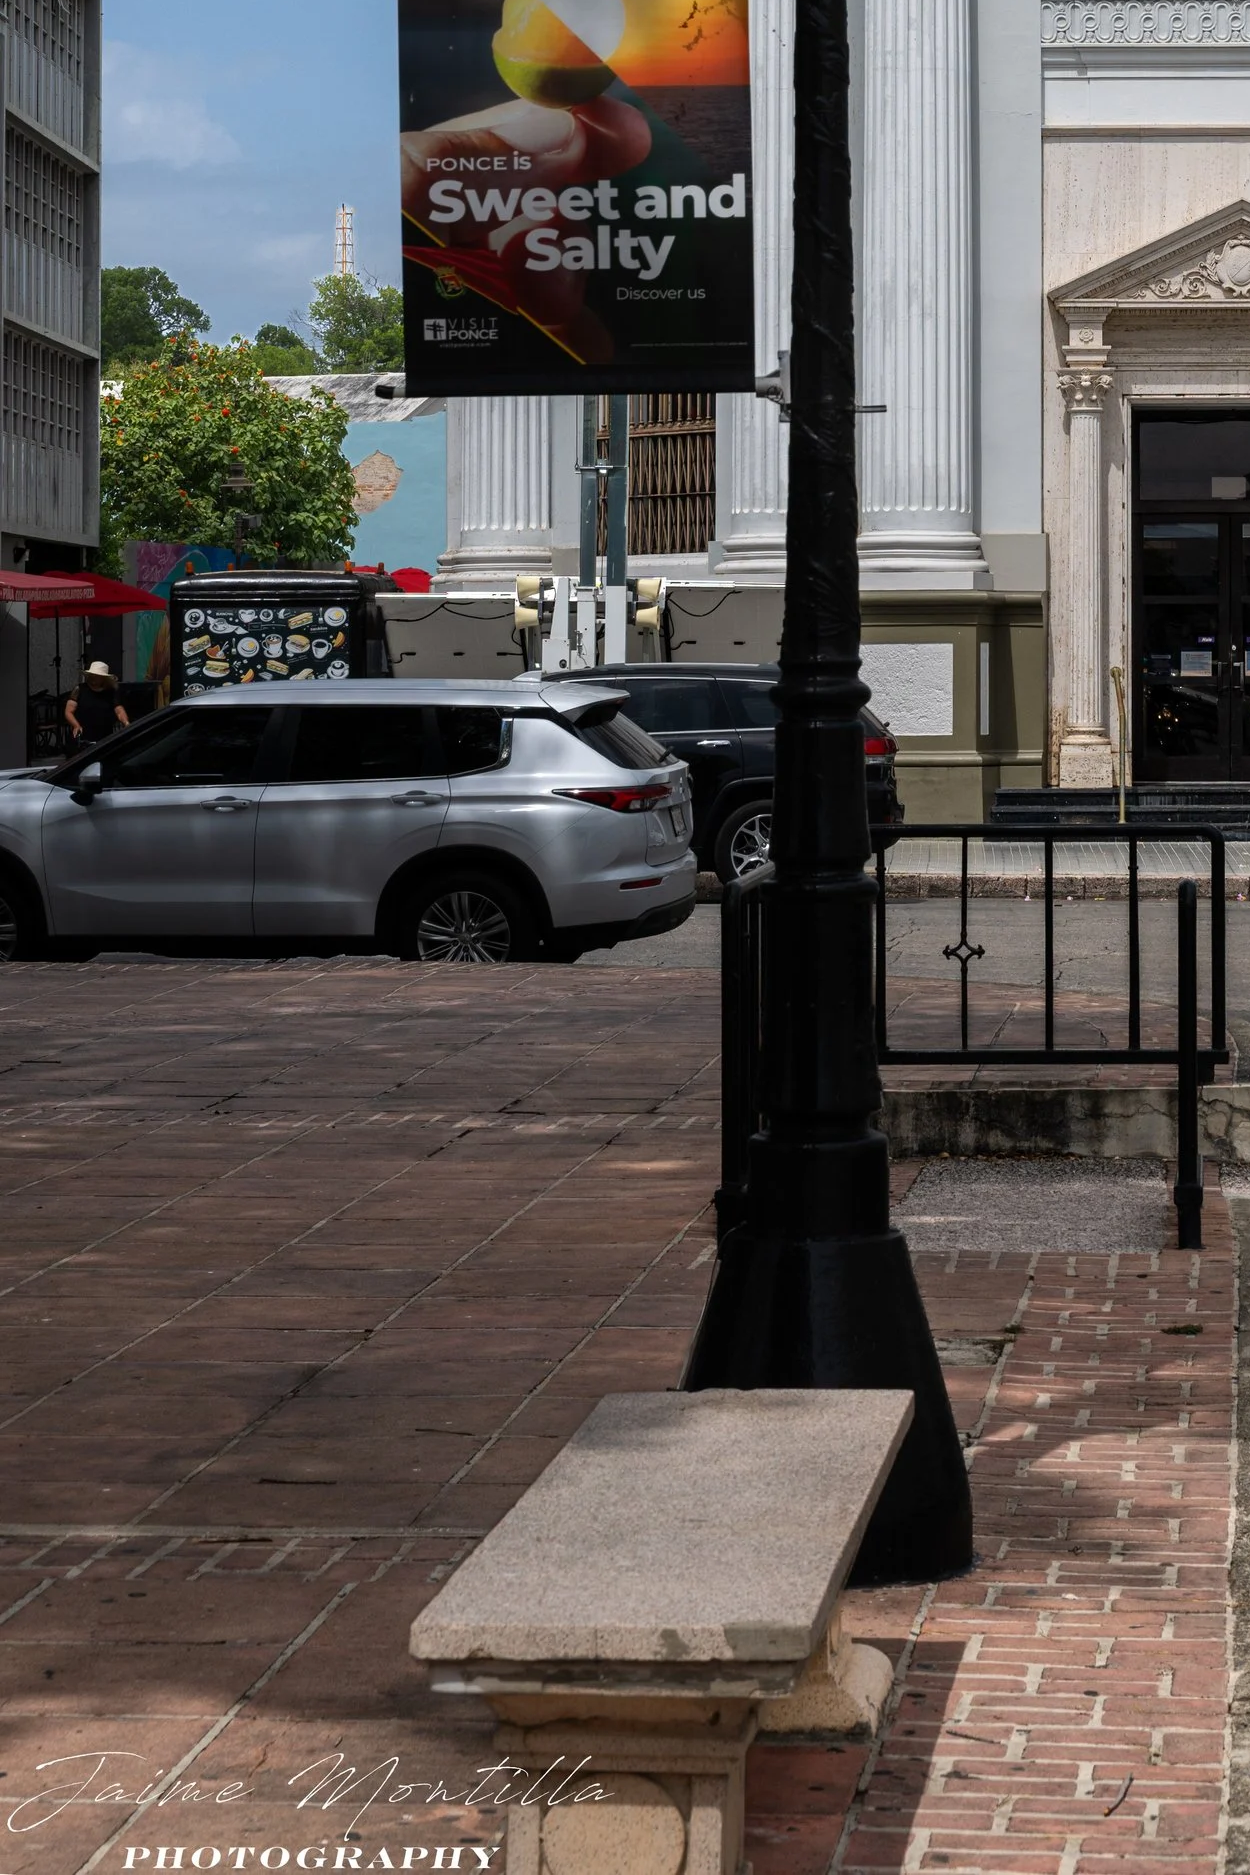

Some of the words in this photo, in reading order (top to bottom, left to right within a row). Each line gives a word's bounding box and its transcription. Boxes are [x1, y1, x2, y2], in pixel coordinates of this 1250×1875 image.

[426, 156, 507, 172] PONCE
[512, 151, 532, 170] is
[428, 179, 620, 223] Sweet
[634, 173, 746, 220] and
[524, 225, 676, 281] Salty
[616, 286, 684, 301] Discover
[687, 288, 706, 300] us
[447, 317, 498, 329] VISIT
[448, 329, 499, 341] PONCE
